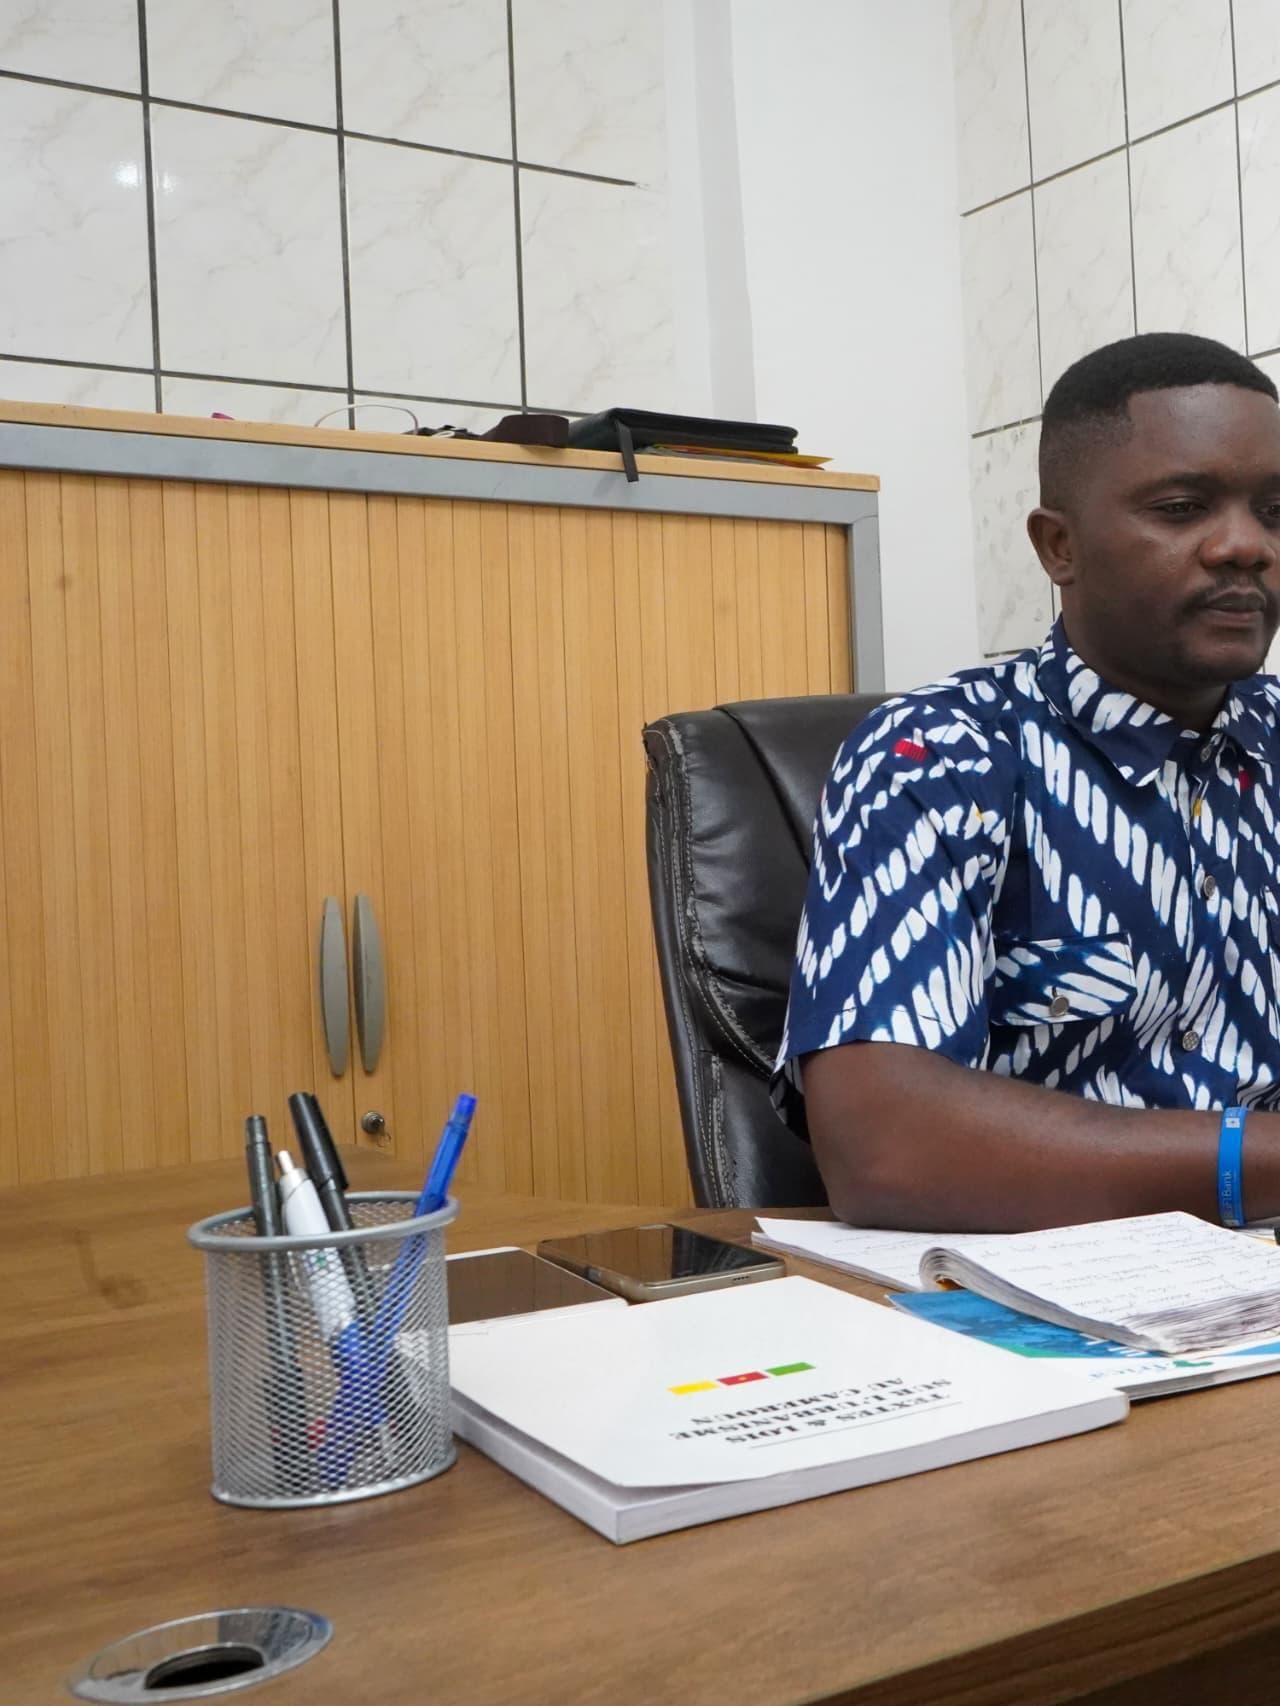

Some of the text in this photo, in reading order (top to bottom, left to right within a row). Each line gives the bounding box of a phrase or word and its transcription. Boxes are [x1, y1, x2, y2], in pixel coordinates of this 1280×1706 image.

[690, 1377, 904, 1426] AU CAMEROUN
[888, 1378, 952, 1397] SUR
[724, 1393, 950, 1444] TEXTES & LOIS
